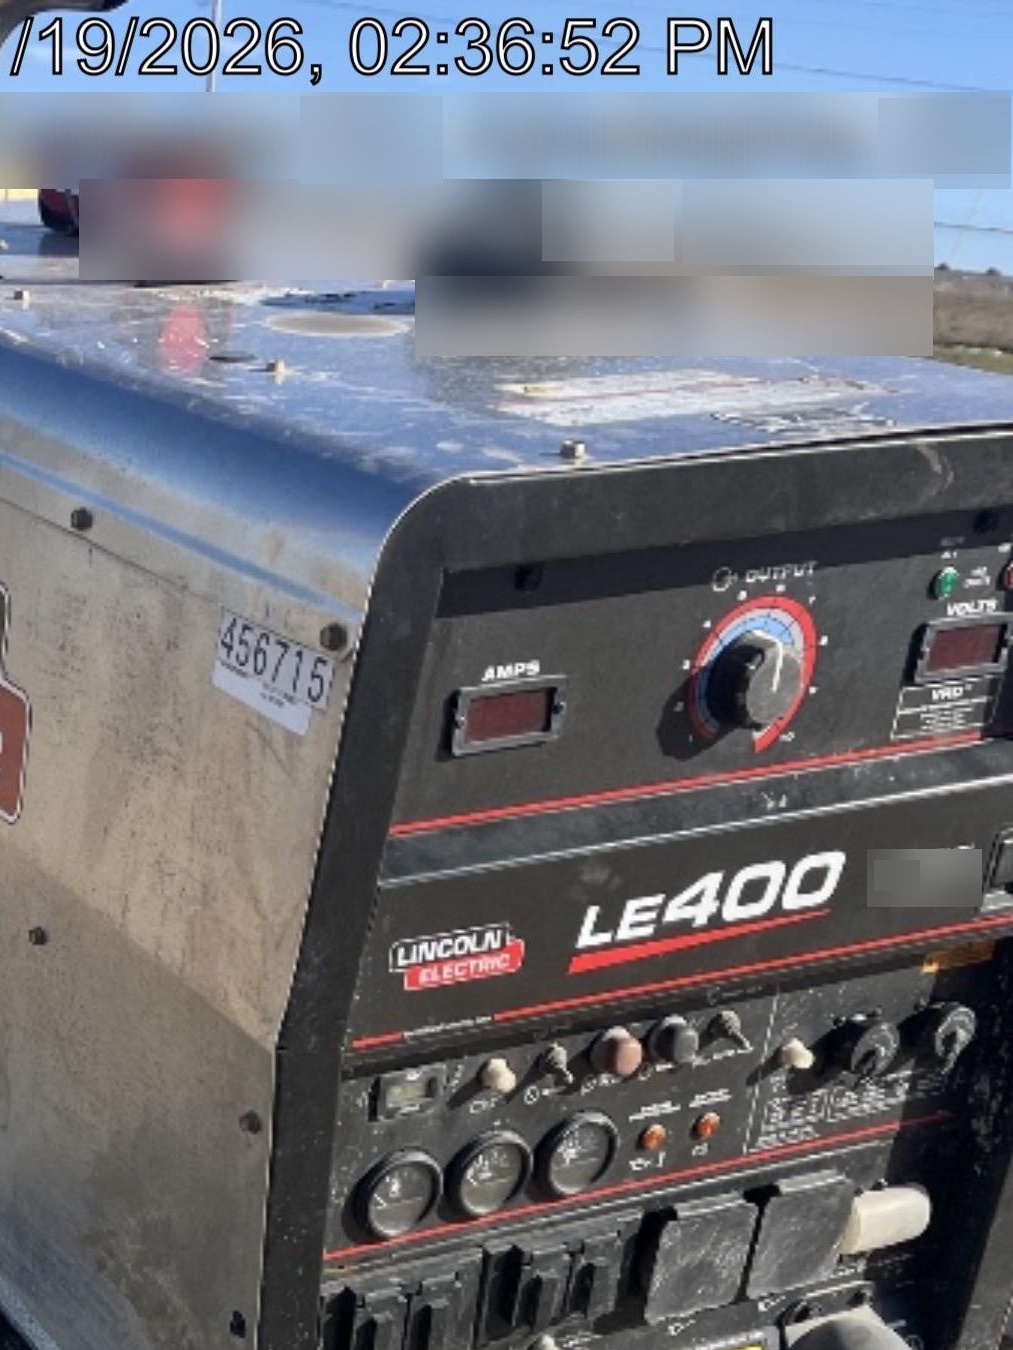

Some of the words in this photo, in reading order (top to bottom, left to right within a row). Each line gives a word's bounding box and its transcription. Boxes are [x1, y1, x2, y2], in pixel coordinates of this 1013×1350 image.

[745, 560, 819, 583] OUTPUT
[946, 599, 998, 617] VOLTS
[220, 618, 328, 703] 456715
[481, 659, 540, 682] AMPS
[575, 851, 846, 950] LE400
[396, 929, 506, 967] LINCOLN
[419, 952, 511, 983] ELECTRIC
